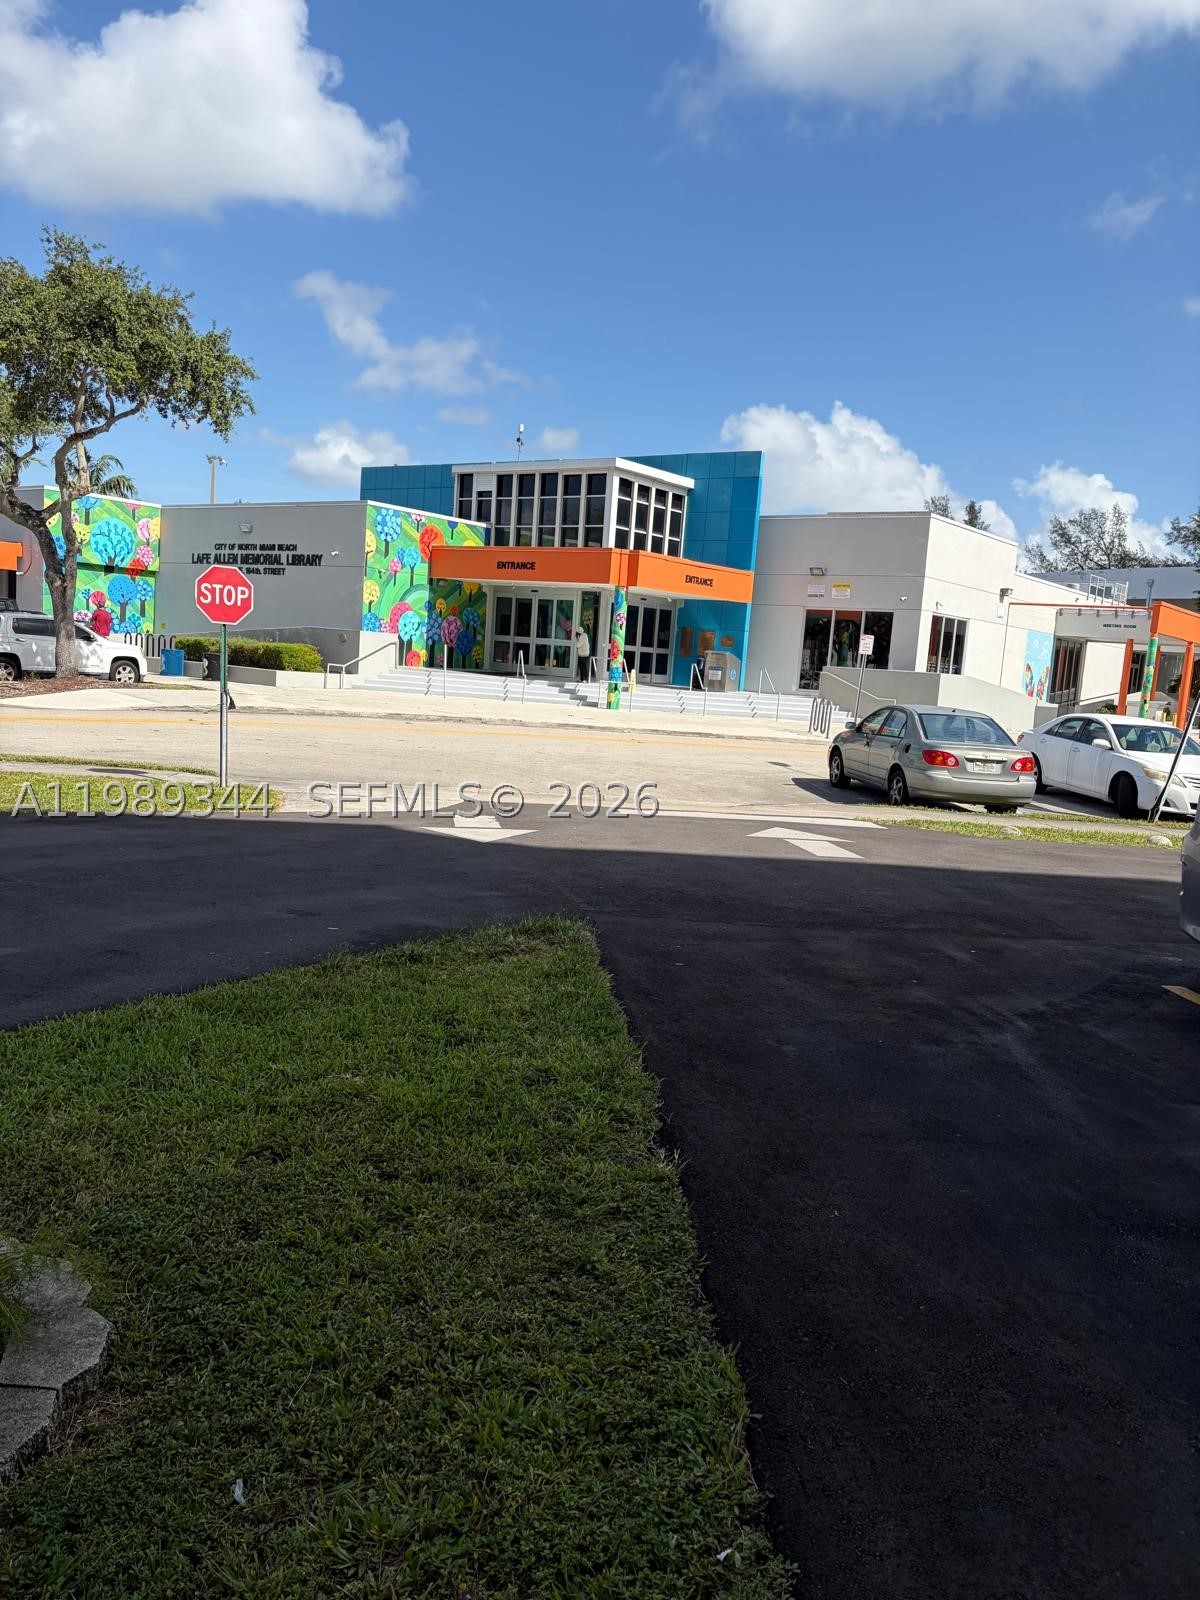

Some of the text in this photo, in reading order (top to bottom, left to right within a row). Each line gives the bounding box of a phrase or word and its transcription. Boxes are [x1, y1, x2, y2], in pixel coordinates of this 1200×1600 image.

[214, 543, 298, 552] CITY OF NORTH MIAMI BEACH
[191, 552, 323, 567] LAFE ALLEN MEMORIAL LIBRARY
[496, 560, 536, 570] ENTRANCE
[262, 567, 286, 576] STREET
[685, 574, 714, 587] ENTRANCE
[200, 583, 249, 606] STOP
